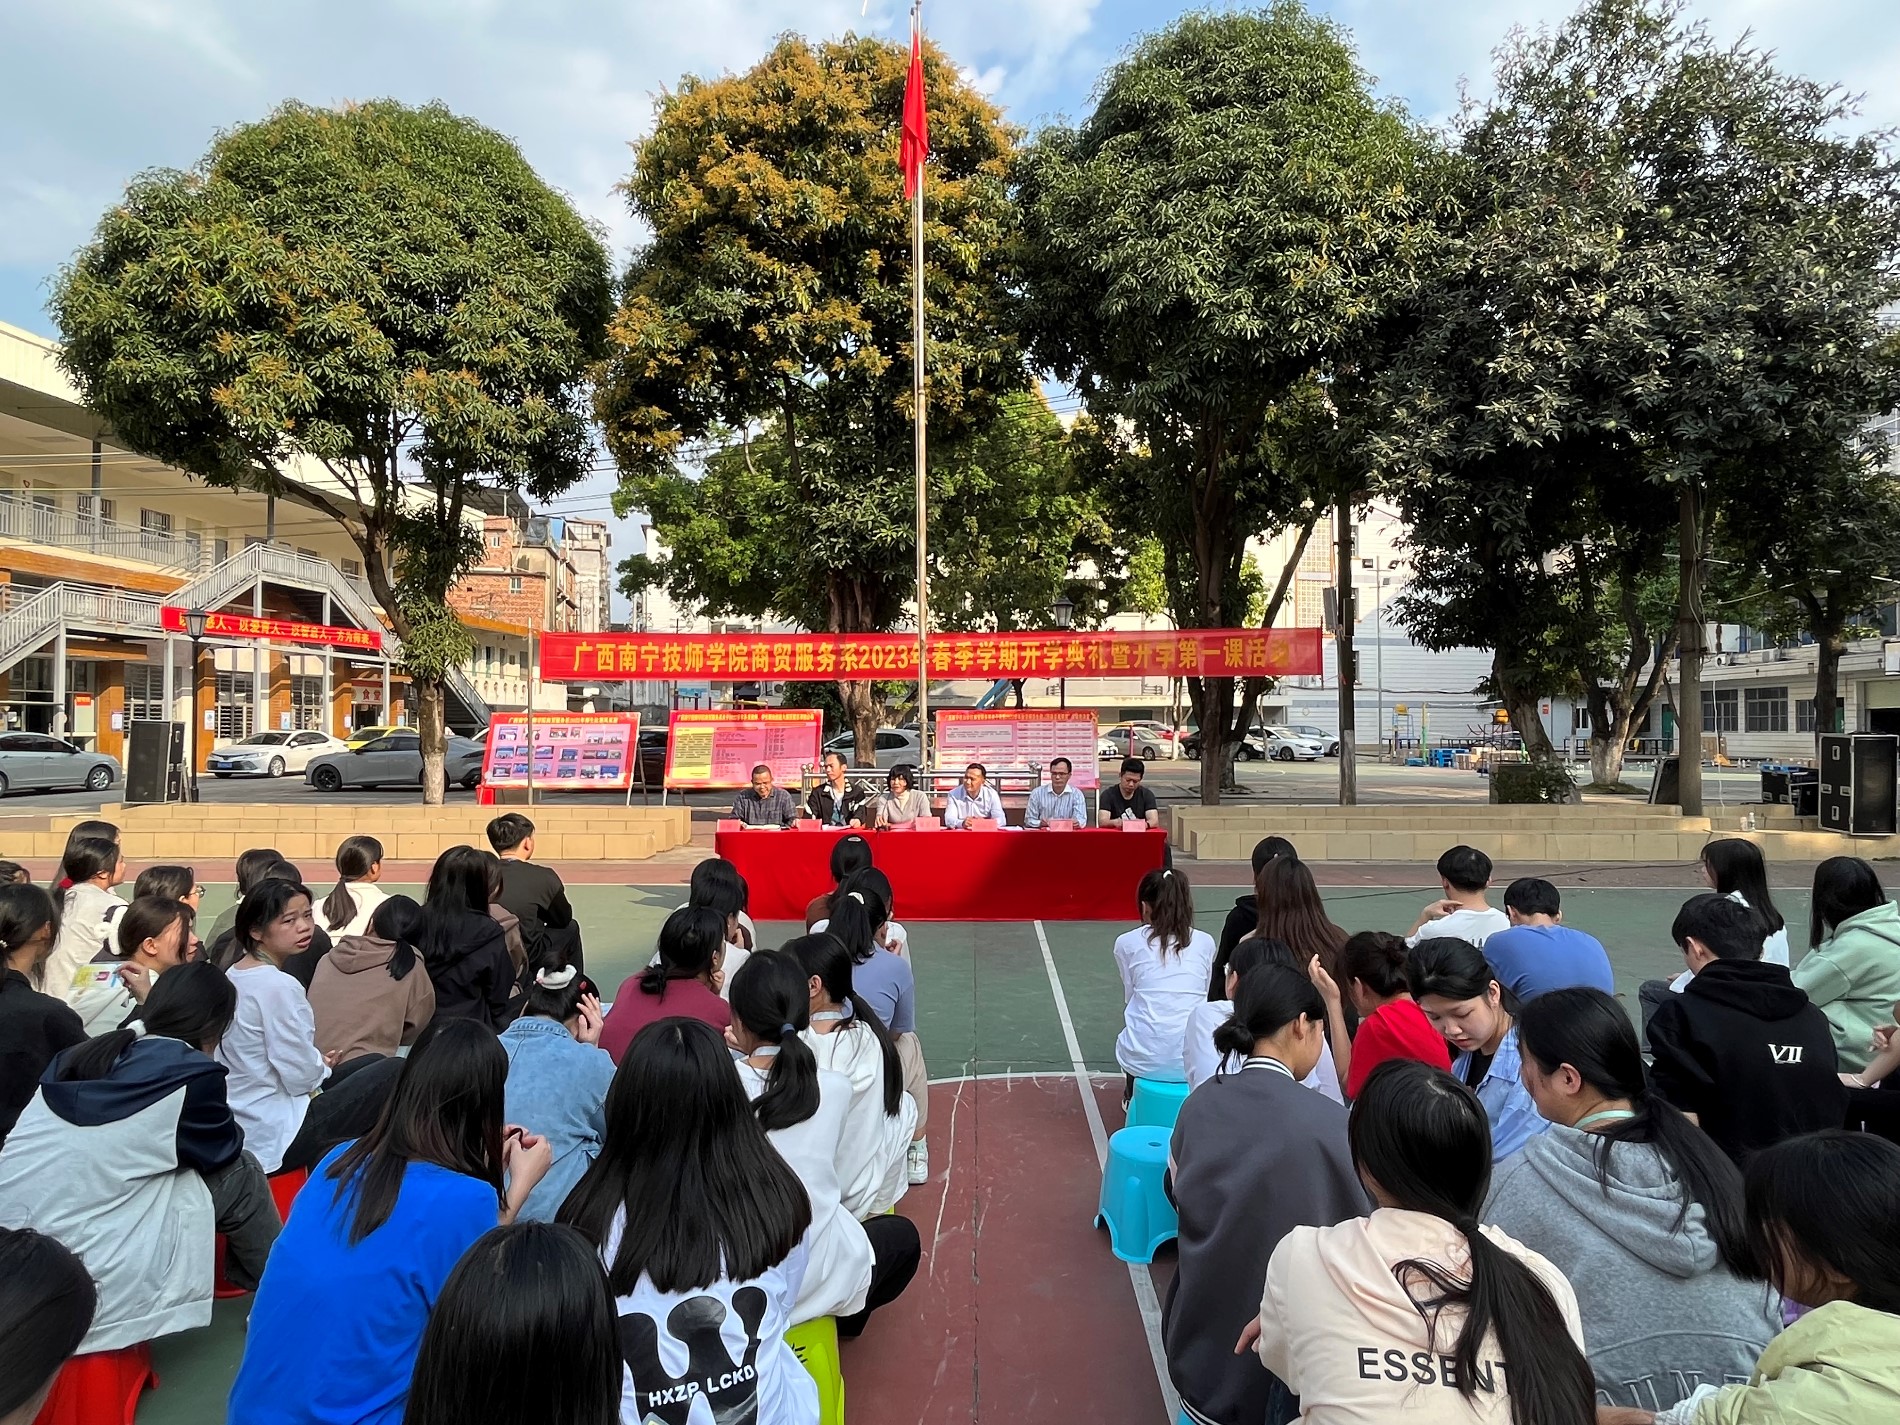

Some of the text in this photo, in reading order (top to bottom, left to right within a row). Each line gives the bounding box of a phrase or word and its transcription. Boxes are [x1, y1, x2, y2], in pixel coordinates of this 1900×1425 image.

[1767, 1043, 1803, 1064] VII
[648, 1364, 755, 1407] HXZP LCKD
[1357, 1347, 1506, 1393] ESSEN
